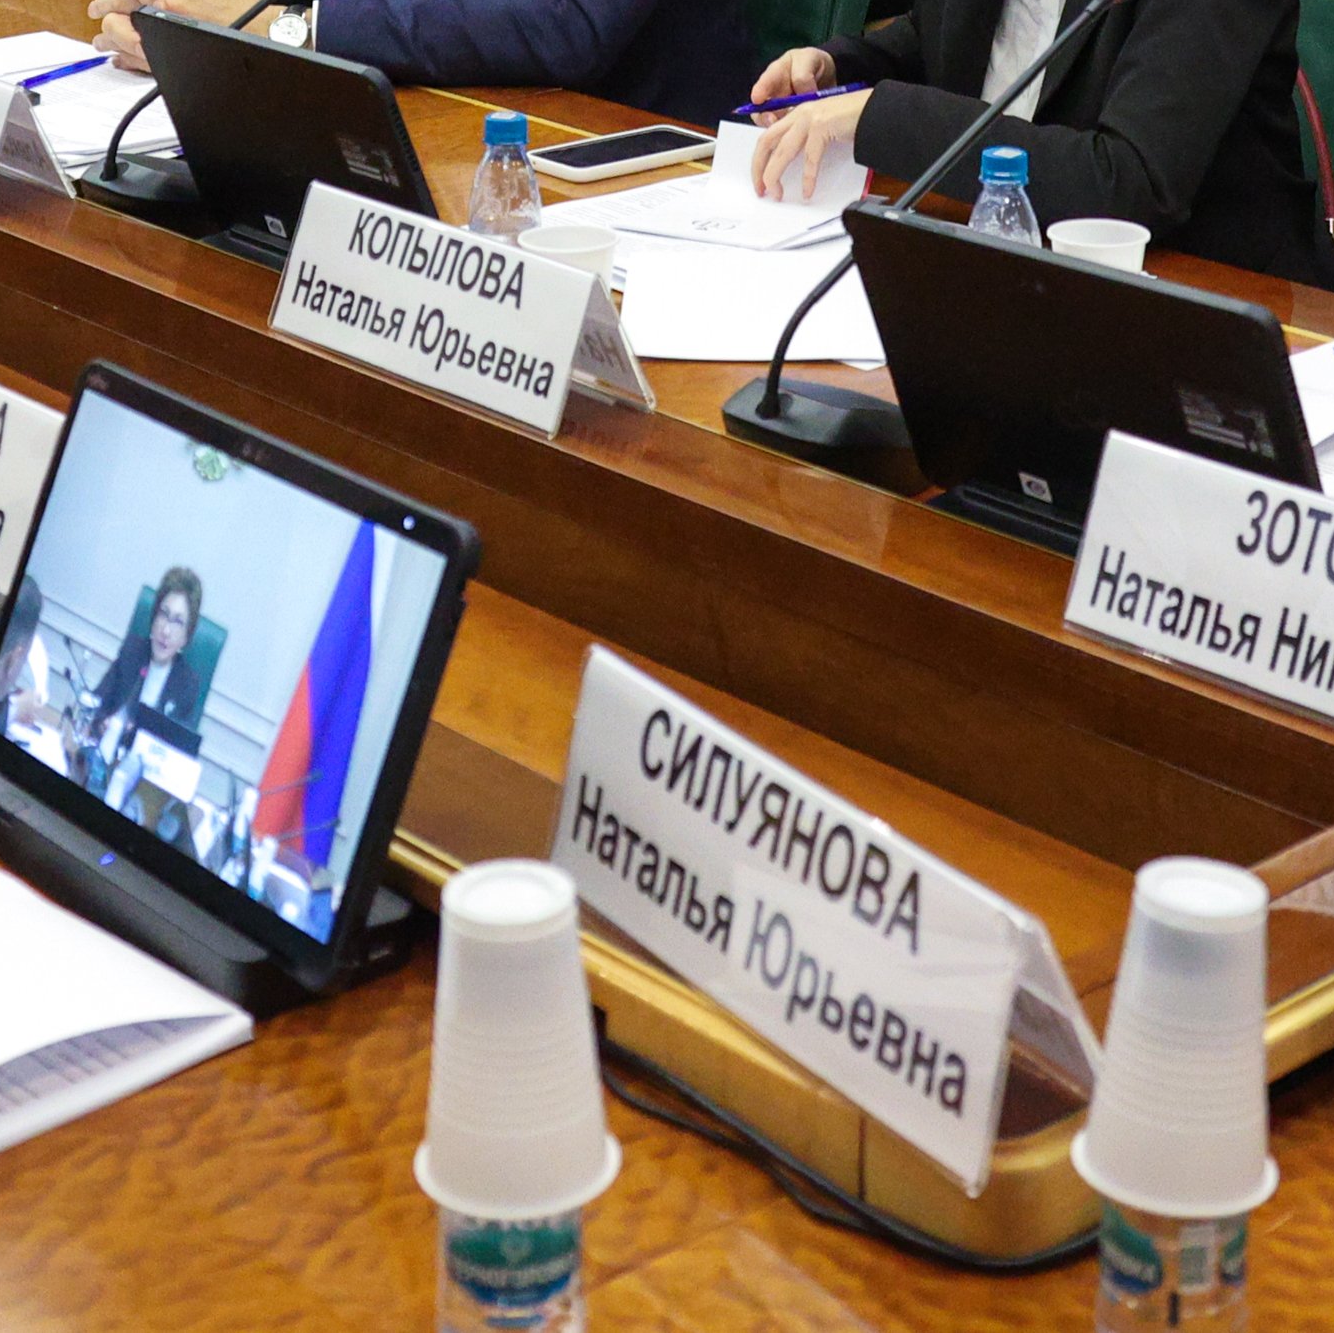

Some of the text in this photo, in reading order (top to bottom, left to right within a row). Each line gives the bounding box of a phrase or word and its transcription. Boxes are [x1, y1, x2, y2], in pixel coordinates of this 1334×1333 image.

[348, 207, 526, 310] КОПЫЛОВА
[290, 260, 556, 400] Наталья Юрьевна
[1089, 544, 1263, 663] Наталья
[639, 708, 923, 958] СИЛУЯНОВА
[573, 774, 968, 1119] Наталья Юрьевна
